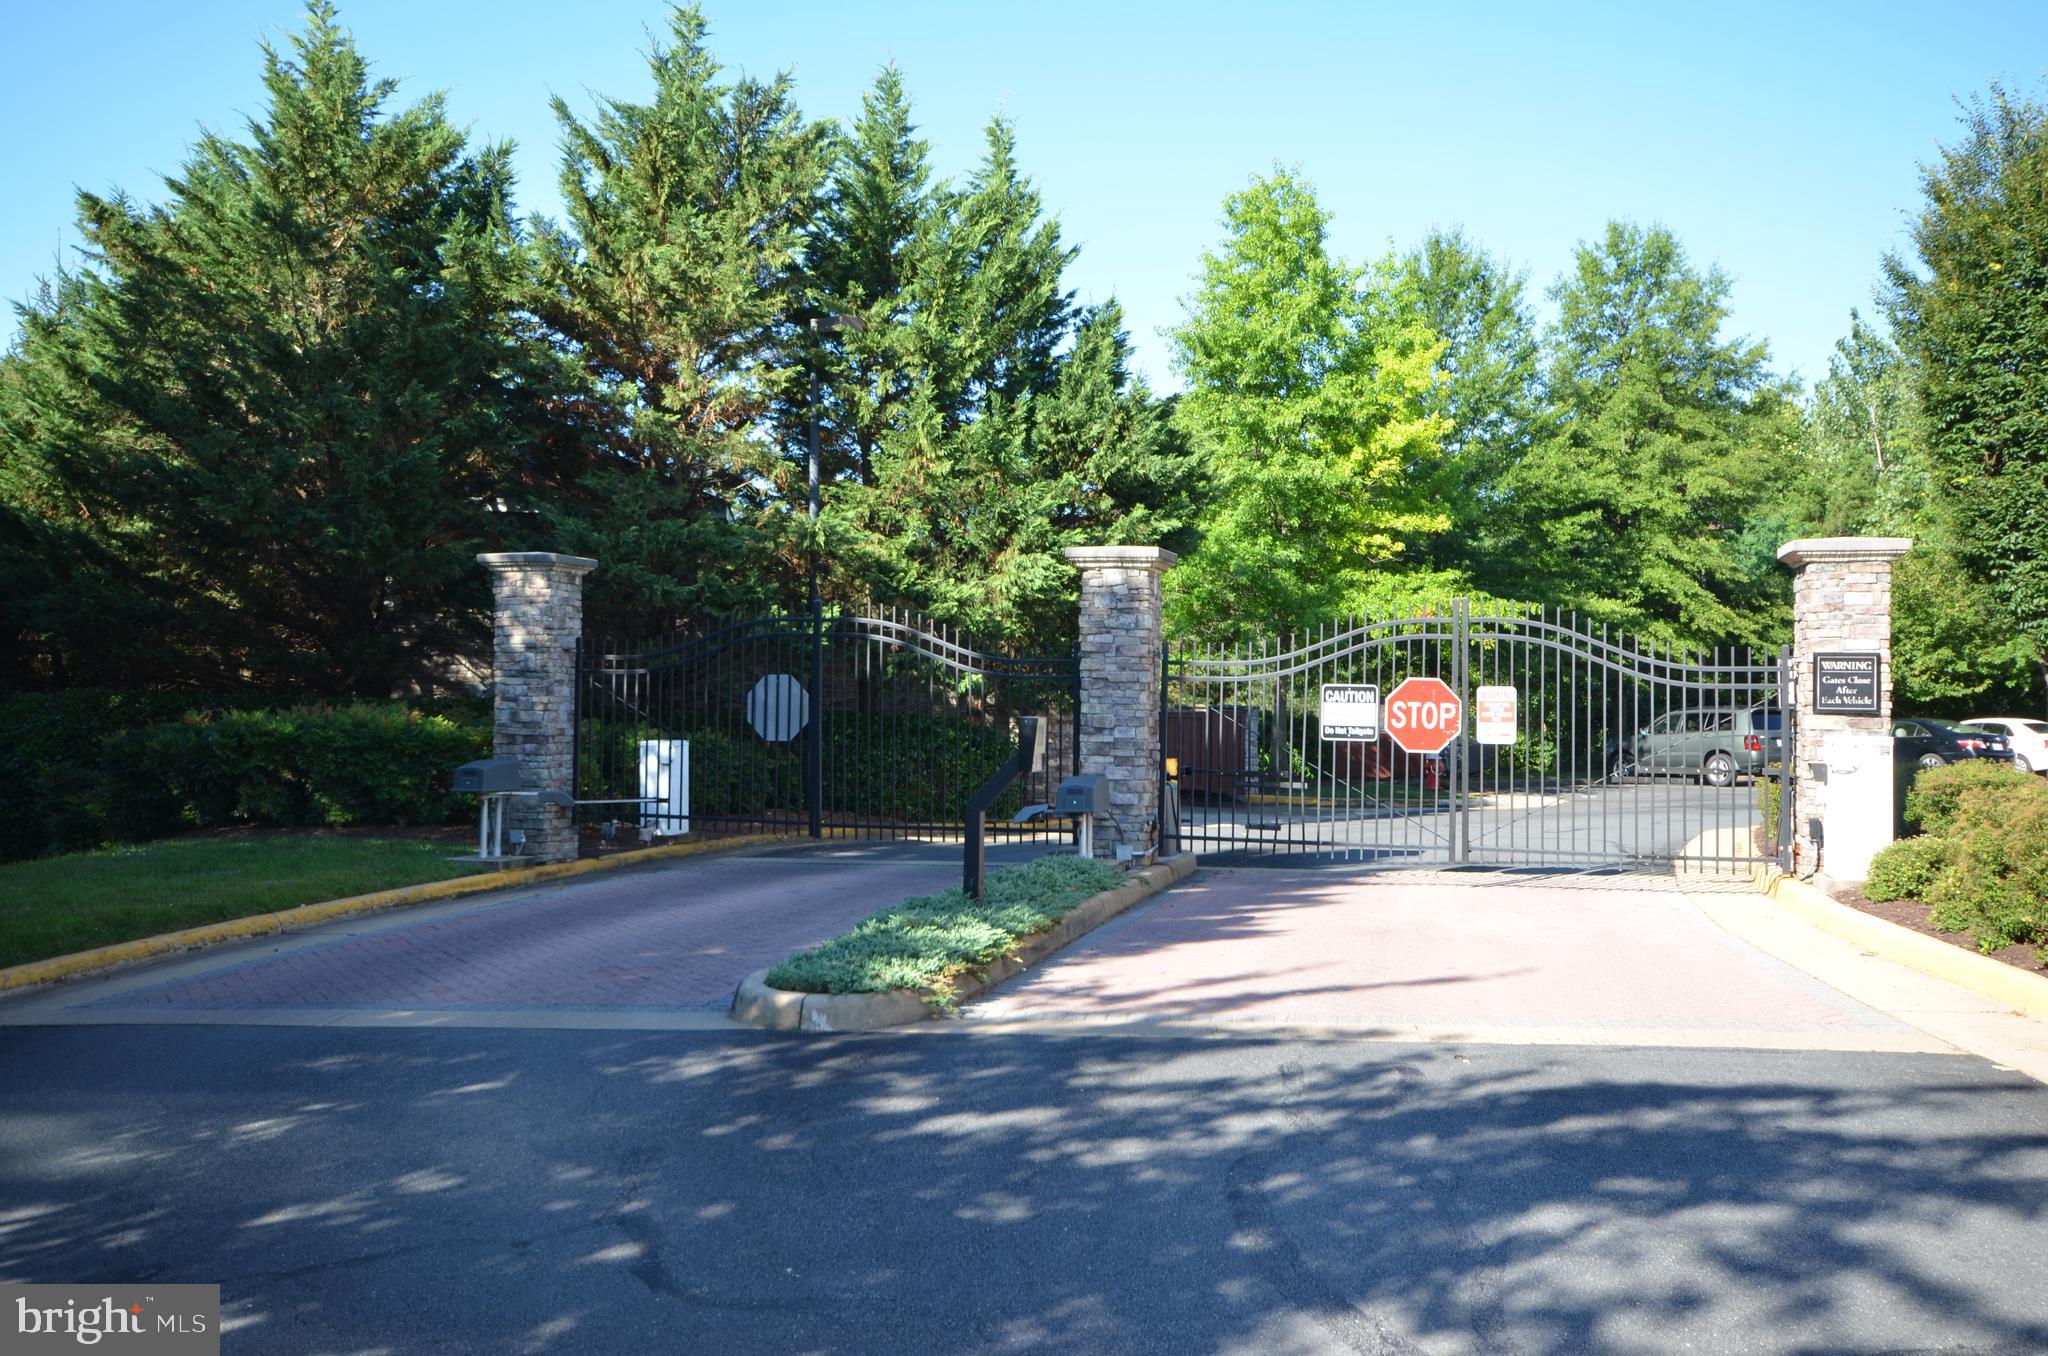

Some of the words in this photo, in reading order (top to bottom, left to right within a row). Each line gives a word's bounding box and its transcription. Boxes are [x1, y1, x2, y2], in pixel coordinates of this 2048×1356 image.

[1821, 661, 1872, 670] WARNING
[1822, 675, 1846, 684] Gates
[1847, 675, 1871, 684] Close
[1836, 685, 1858, 694] After
[1325, 690, 1374, 703] CAUTION
[1821, 696, 1841, 704] Each
[1842, 696, 1872, 704] Vehicle
[1390, 701, 1456, 730] STOP
[1325, 727, 1334, 735] Do
[1335, 727, 1347, 735] Not
[1348, 727, 1373, 736] Tailgate
